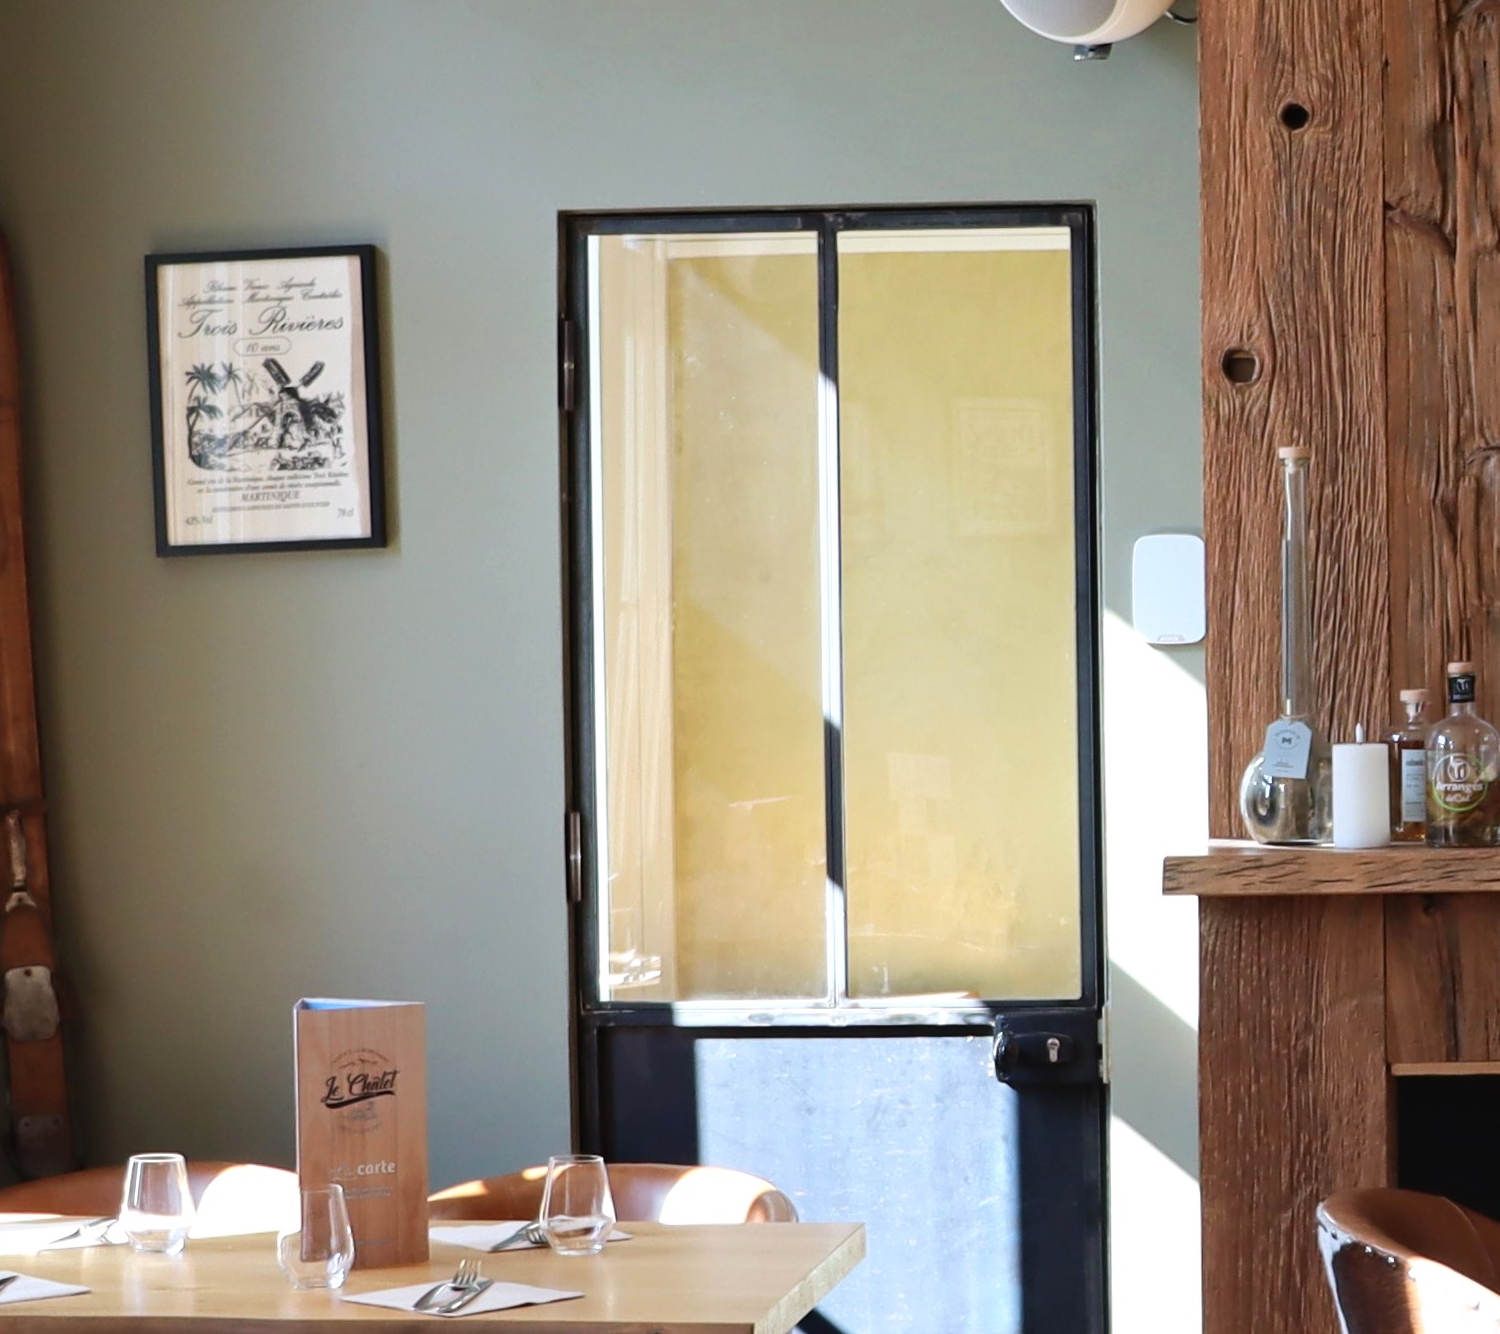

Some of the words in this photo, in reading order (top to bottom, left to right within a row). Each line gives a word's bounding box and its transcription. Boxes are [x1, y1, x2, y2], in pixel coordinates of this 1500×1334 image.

[178, 309, 238, 338] Trois
[241, 490, 300, 502] MARTINIQUE
[320, 1075, 345, 1103] Le
[347, 1069, 401, 1096] Châlet
[357, 1159, 397, 1176] carte
